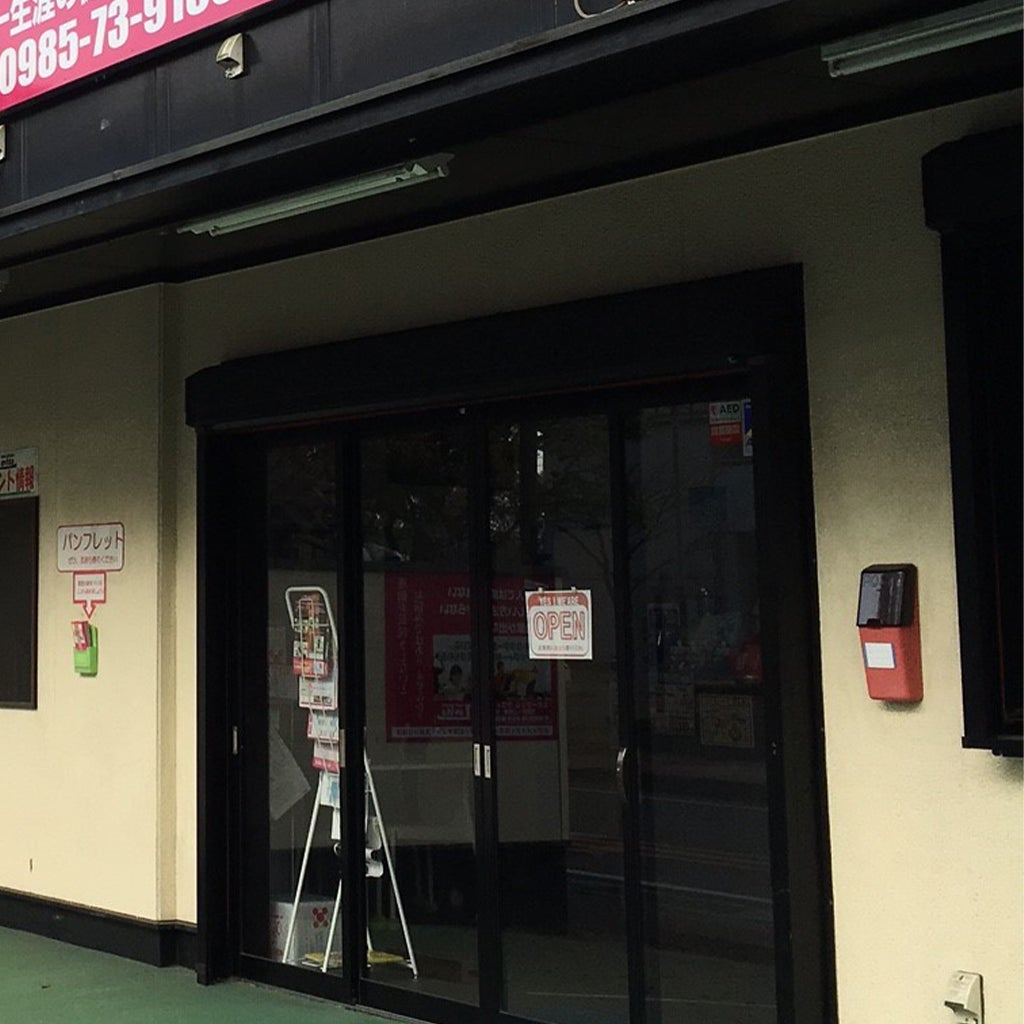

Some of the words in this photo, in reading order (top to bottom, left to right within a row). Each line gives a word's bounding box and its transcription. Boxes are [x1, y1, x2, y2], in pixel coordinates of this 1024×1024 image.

[62, 530, 124, 550] パンフレット
[533, 611, 586, 640] OPEN
